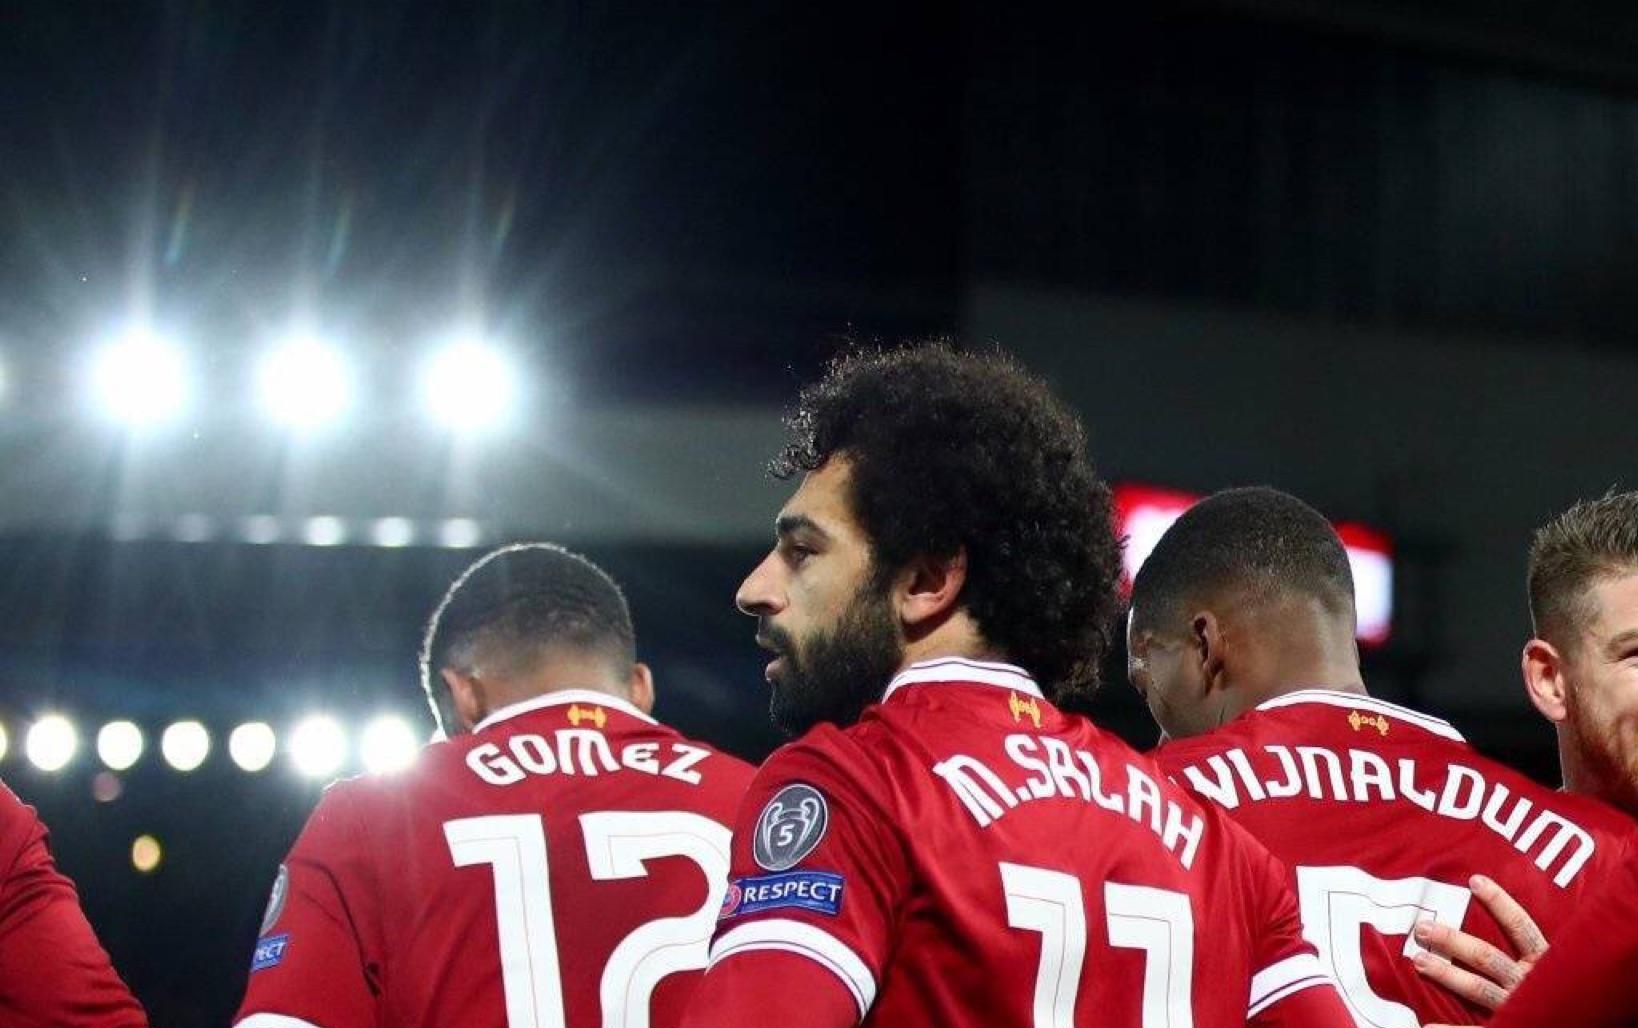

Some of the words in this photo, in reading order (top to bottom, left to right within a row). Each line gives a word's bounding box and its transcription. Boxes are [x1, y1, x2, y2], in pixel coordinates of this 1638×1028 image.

[465, 729, 712, 786] GOMEZ
[932, 734, 1205, 872] M.SALAH
[776, 823, 796, 847] 5
[743, 880, 843, 904] RESPECT
